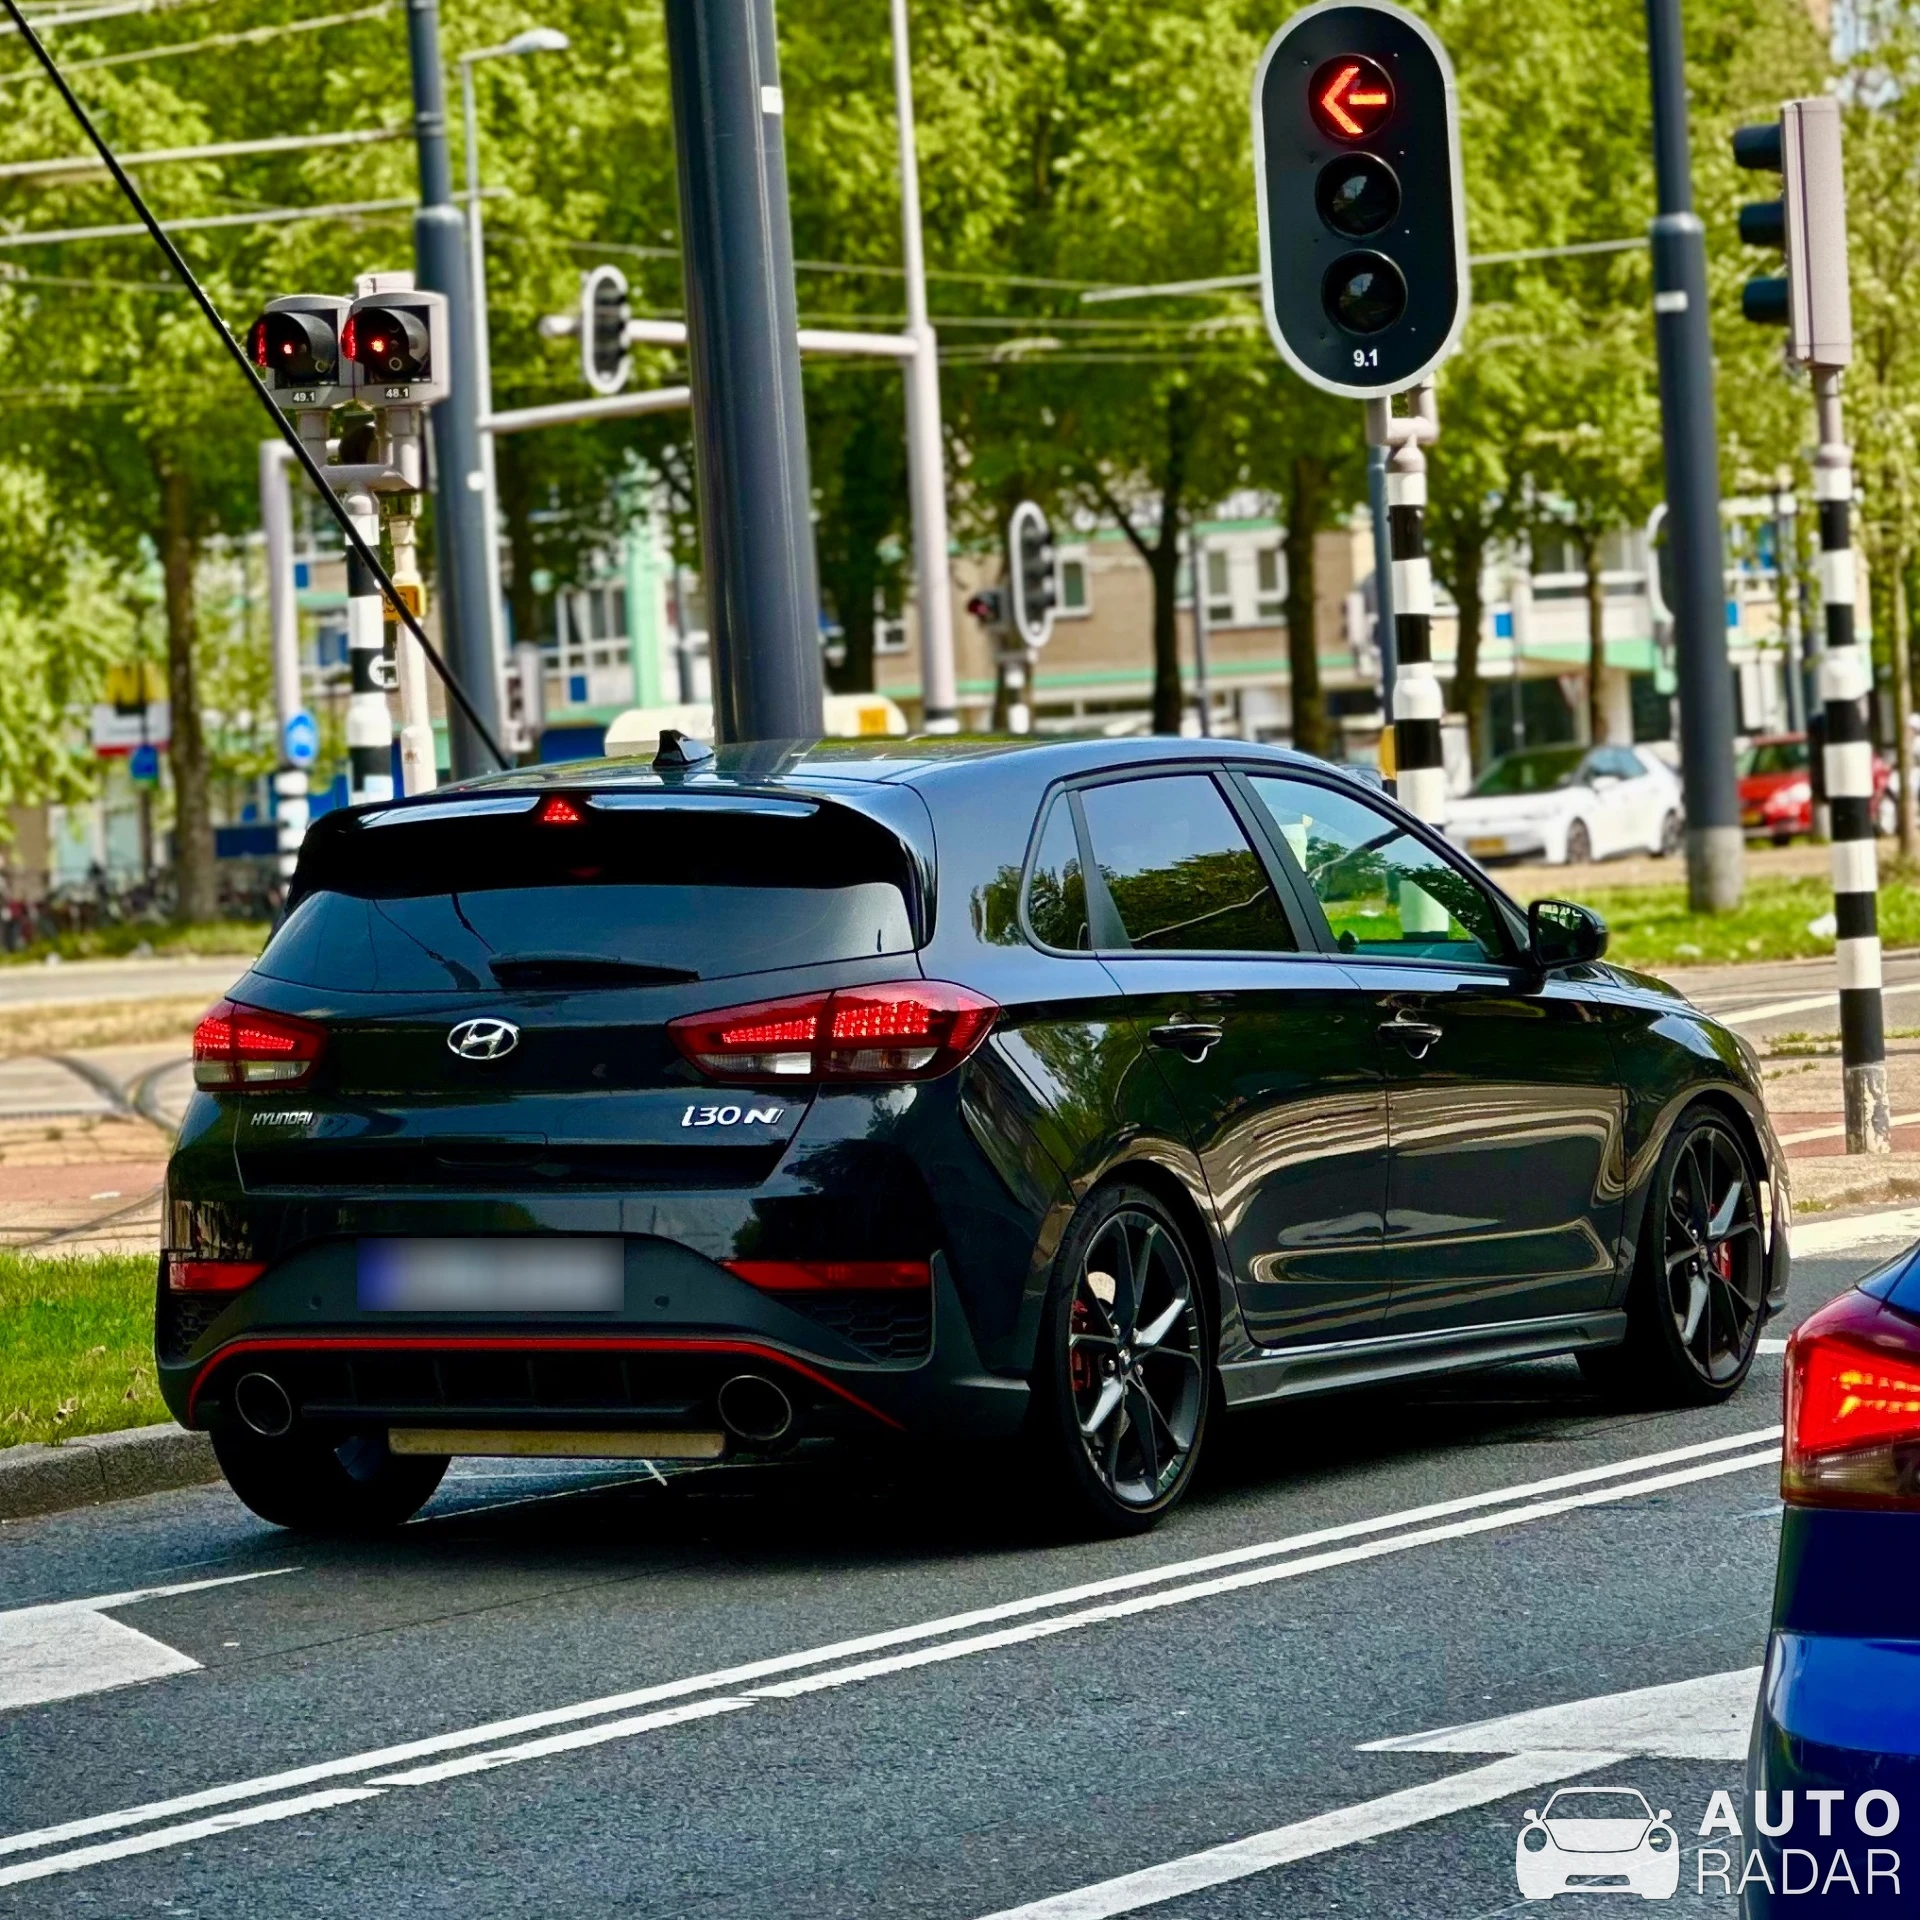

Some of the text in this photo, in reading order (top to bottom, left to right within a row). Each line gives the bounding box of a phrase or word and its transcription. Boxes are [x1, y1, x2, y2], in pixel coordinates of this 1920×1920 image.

[1353, 348, 1378, 368] 9.1
[293, 391, 316, 402] 49.1
[385, 387, 409, 398] 48.1
[250, 1111, 314, 1126] HYUNDAI
[743, 1107, 785, 1124] N
